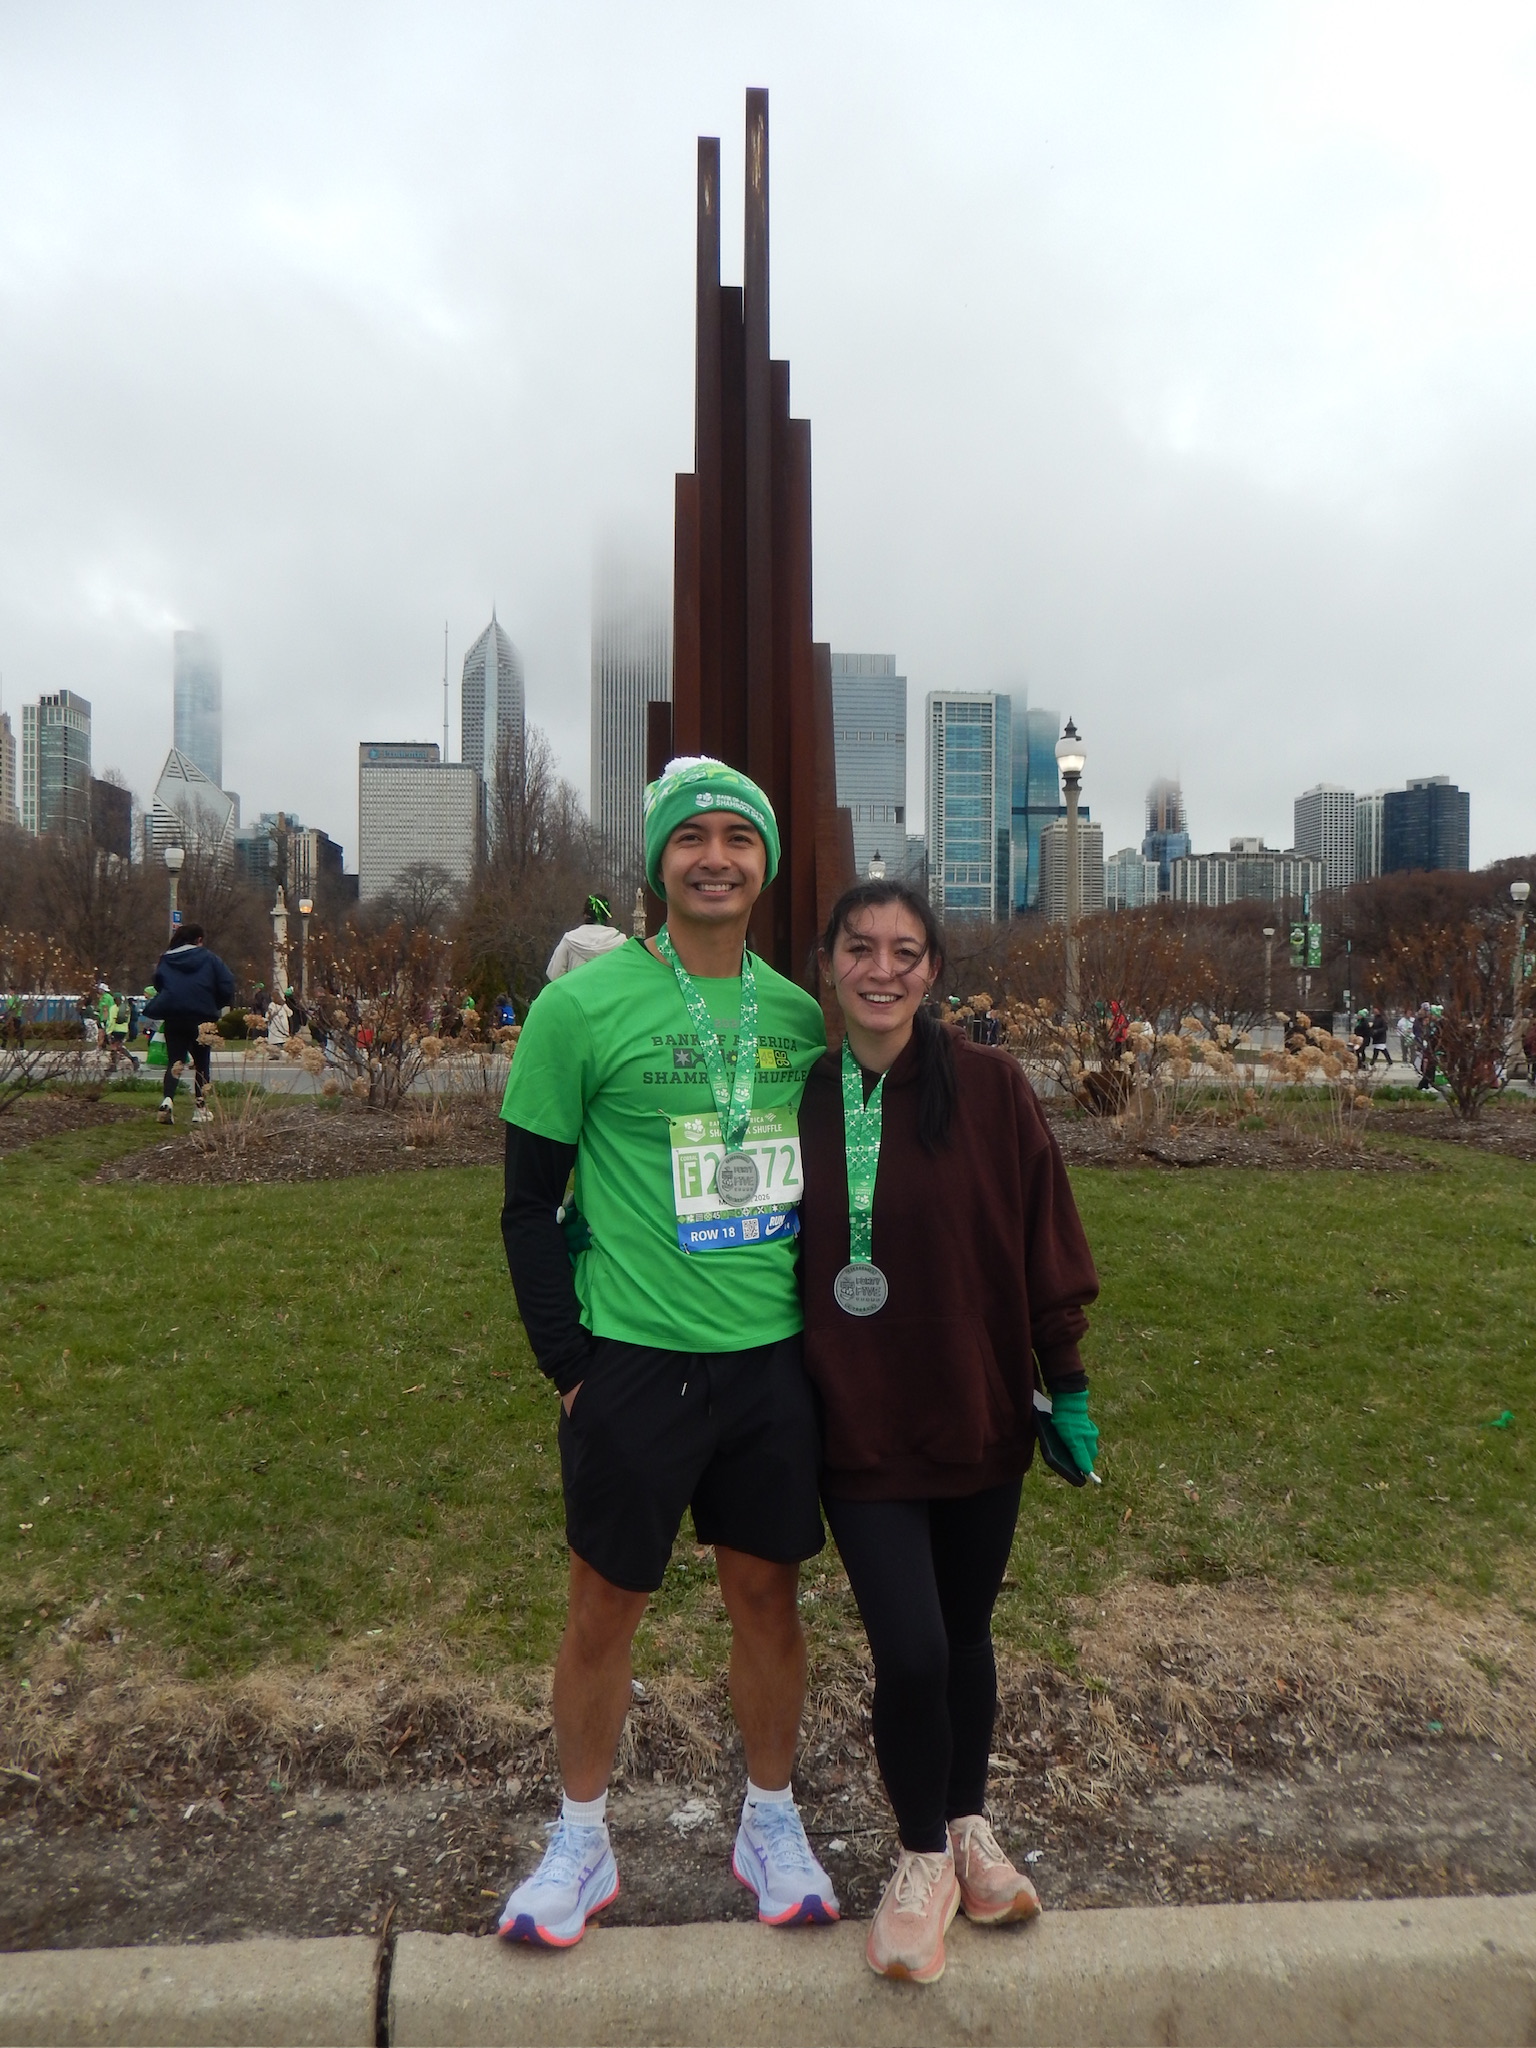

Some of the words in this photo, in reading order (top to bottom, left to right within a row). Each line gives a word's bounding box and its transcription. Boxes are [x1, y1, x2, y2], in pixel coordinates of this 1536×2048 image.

[754, 1070, 808, 1085] HUFFLE
[753, 1123, 783, 1135] SHUFFLE
[683, 1160, 697, 1198] F
[754, 1193, 770, 1203] 2026
[690, 1229, 718, 1242] ROW
[722, 1226, 736, 1239] 18
